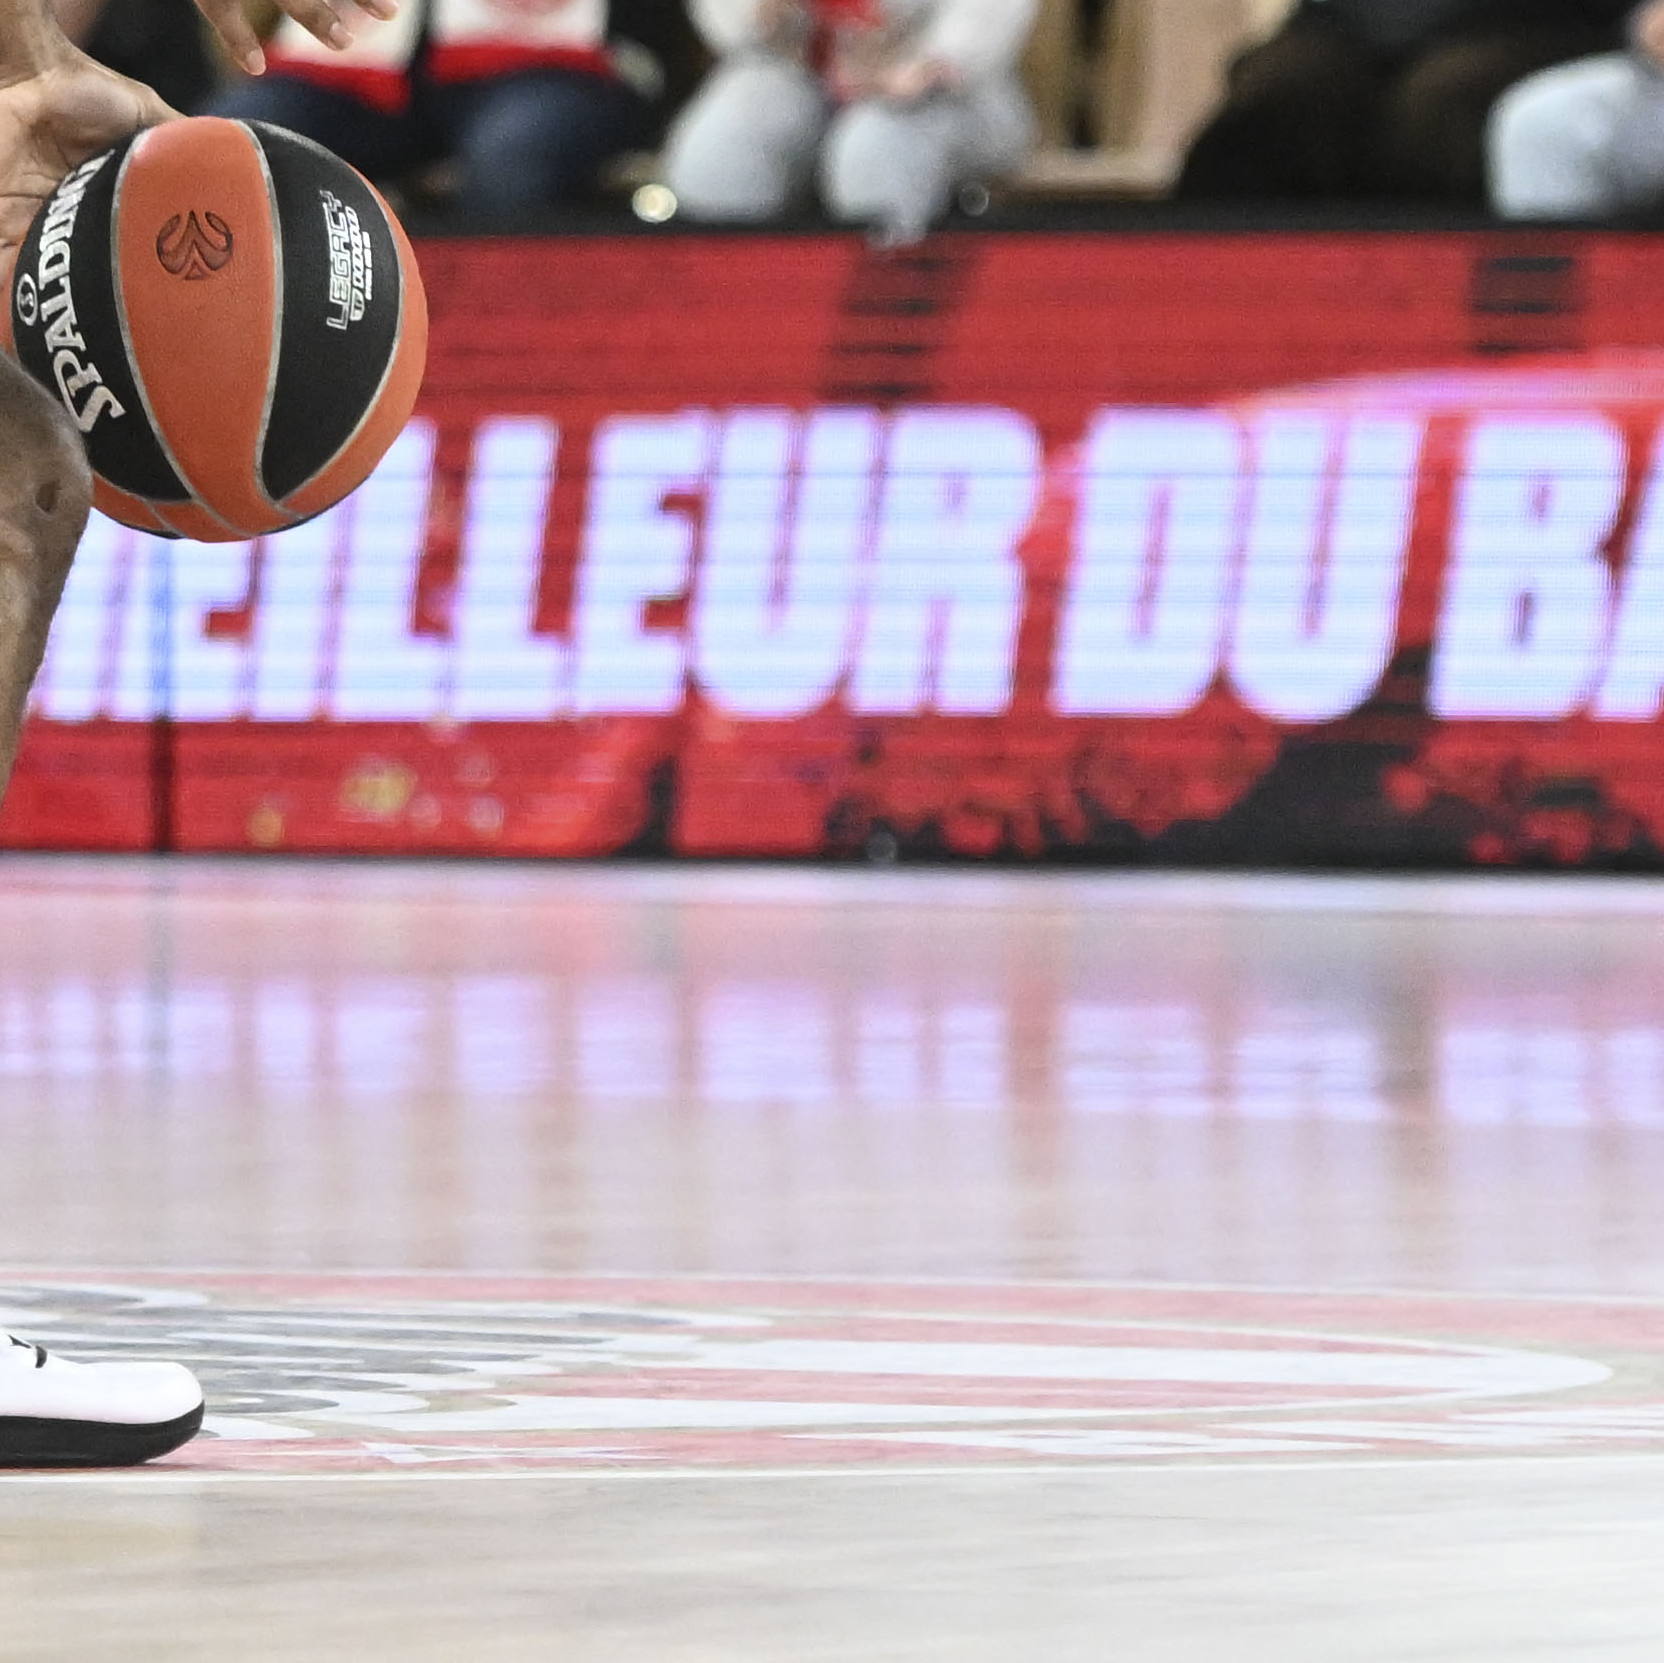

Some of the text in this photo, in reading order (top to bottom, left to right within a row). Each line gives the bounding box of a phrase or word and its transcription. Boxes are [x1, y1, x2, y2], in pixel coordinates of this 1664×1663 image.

[319, 189, 353, 331] LEGACY
[18, 406, 1041, 722] EILLEUR
[1048, 404, 1430, 723] DU
